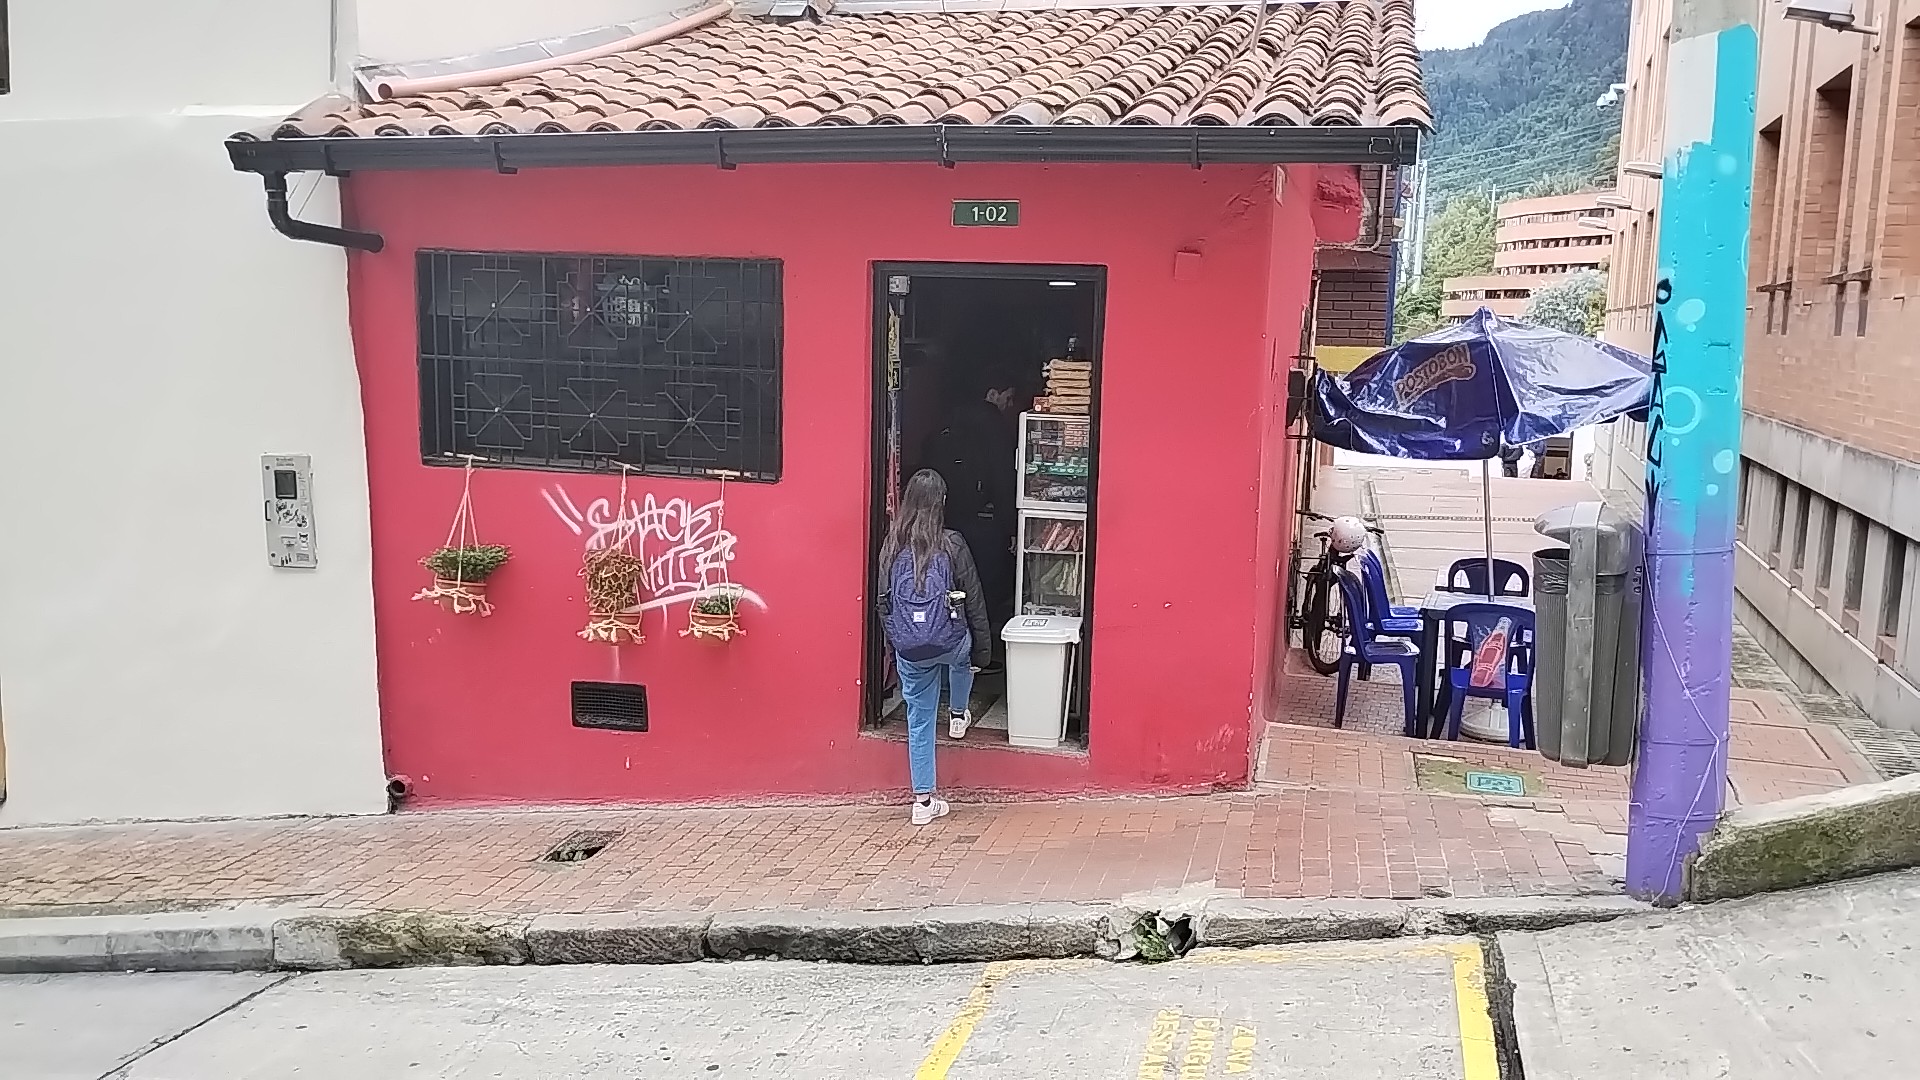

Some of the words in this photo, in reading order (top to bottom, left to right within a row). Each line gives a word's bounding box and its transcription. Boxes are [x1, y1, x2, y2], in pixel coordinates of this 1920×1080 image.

[971, 206, 1008, 222] 1-02
[1136, 1008, 1184, 1080] DESCAR
[1177, 1017, 1221, 1080] CARGU
[1223, 1025, 1257, 1074] ZONA
